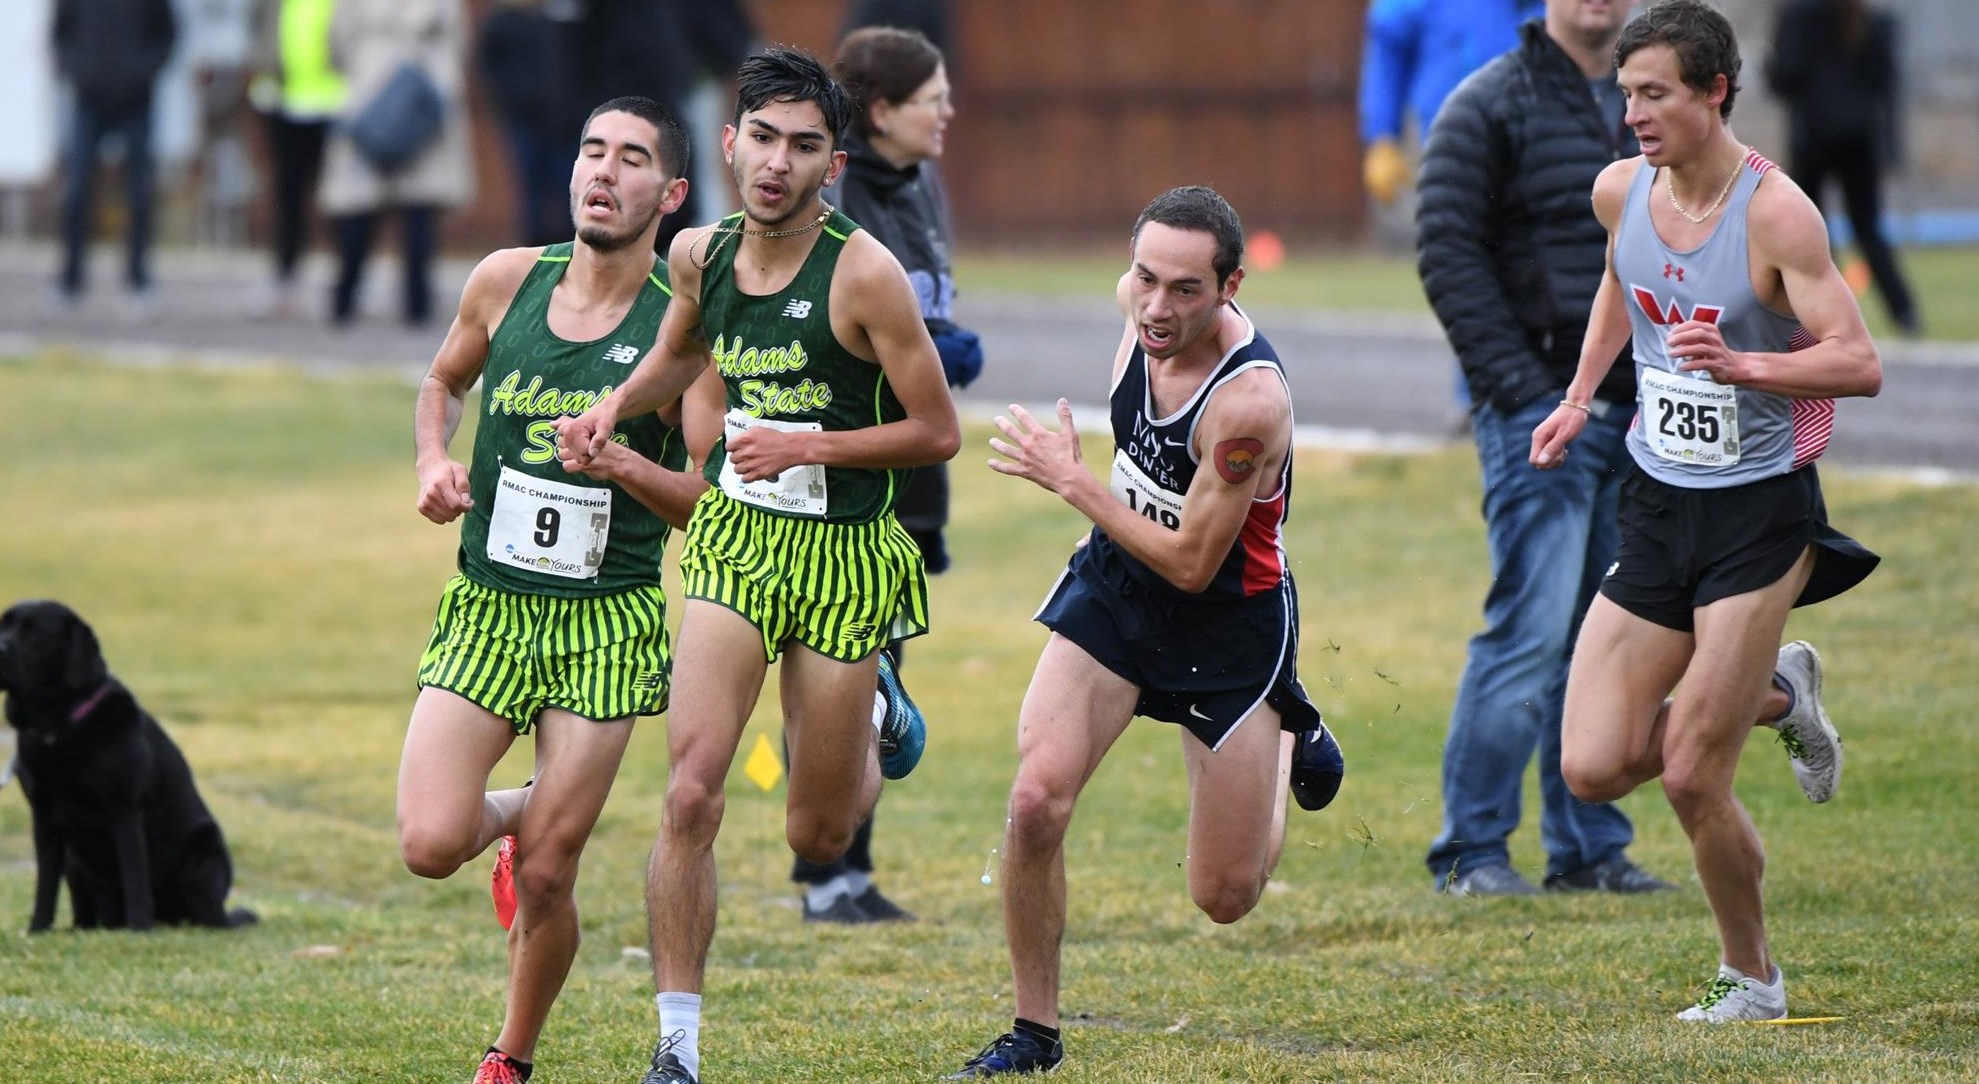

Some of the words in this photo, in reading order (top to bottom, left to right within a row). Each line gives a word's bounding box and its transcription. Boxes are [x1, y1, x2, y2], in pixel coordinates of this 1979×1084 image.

[711, 332, 808, 378] Adams
[739, 378, 833, 418] State
[1666, 385, 1733, 400] CHAMPIONSHIP
[1658, 397, 1720, 443] 235
[502, 480, 526, 494] RMAC
[528, 488, 608, 508] CHAMPIONSHIP
[743, 488, 767, 501] MAKE
[778, 495, 807, 508] YOURS
[533, 506, 561, 548] 9
[512, 554, 536, 566] MAKE
[550, 558, 582, 574] YOURS
